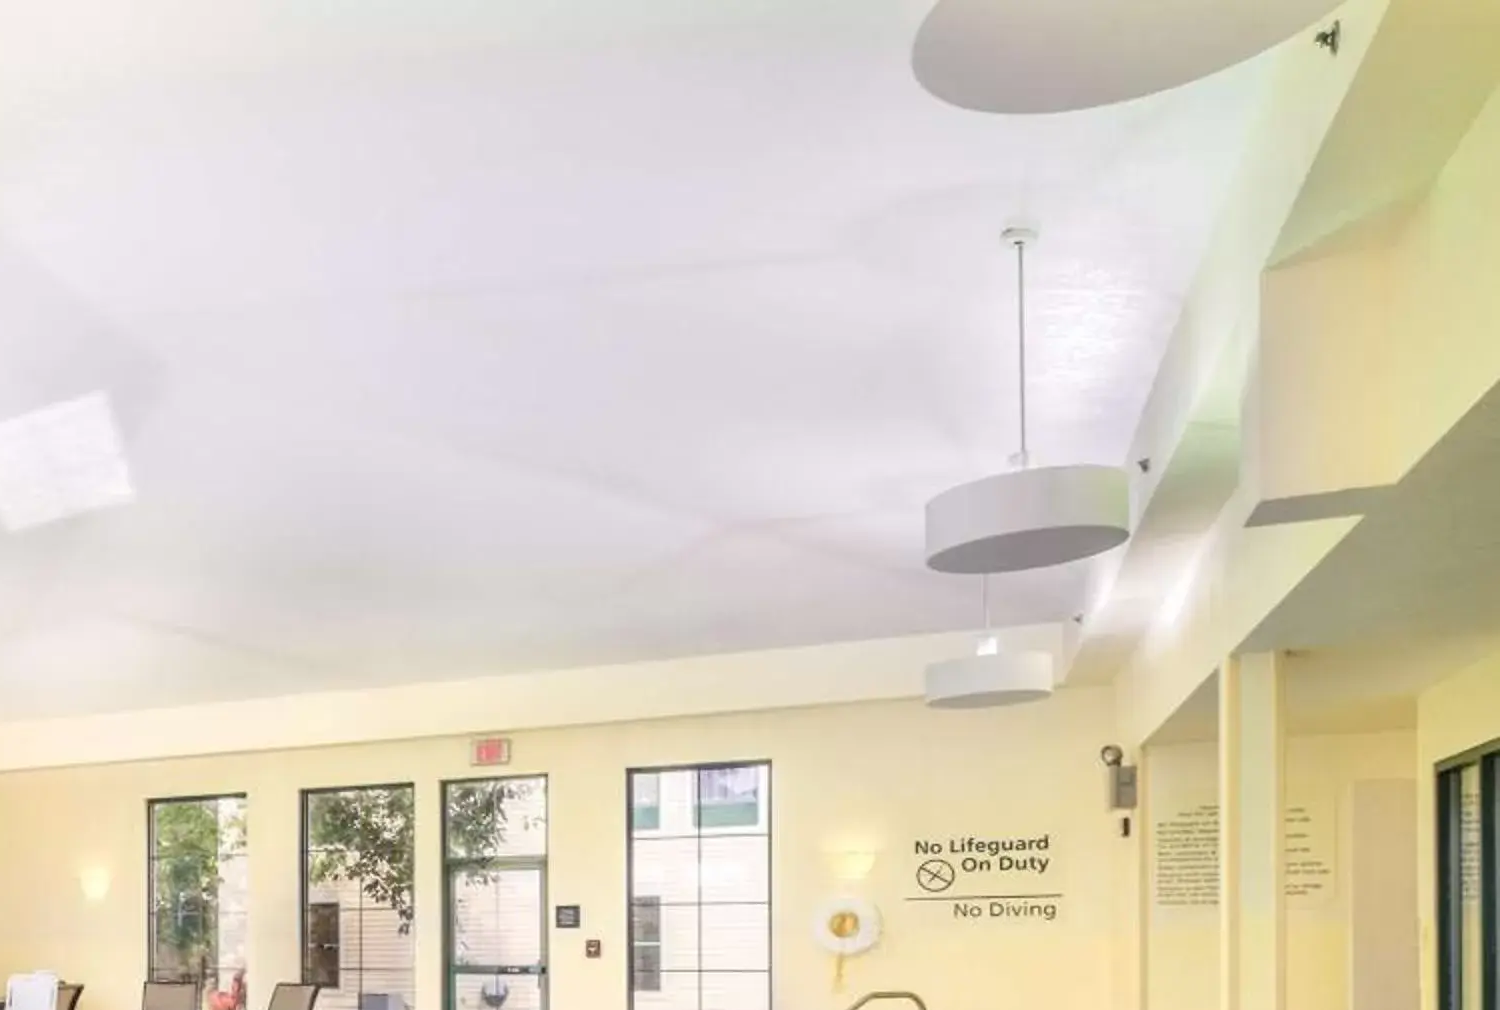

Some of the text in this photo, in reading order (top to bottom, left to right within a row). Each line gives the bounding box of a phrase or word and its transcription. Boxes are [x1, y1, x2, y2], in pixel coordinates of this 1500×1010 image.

[914, 834, 1049, 857] No Lifeguard
[961, 855, 1050, 874] On Duty
[953, 901, 1057, 921] No Diving
